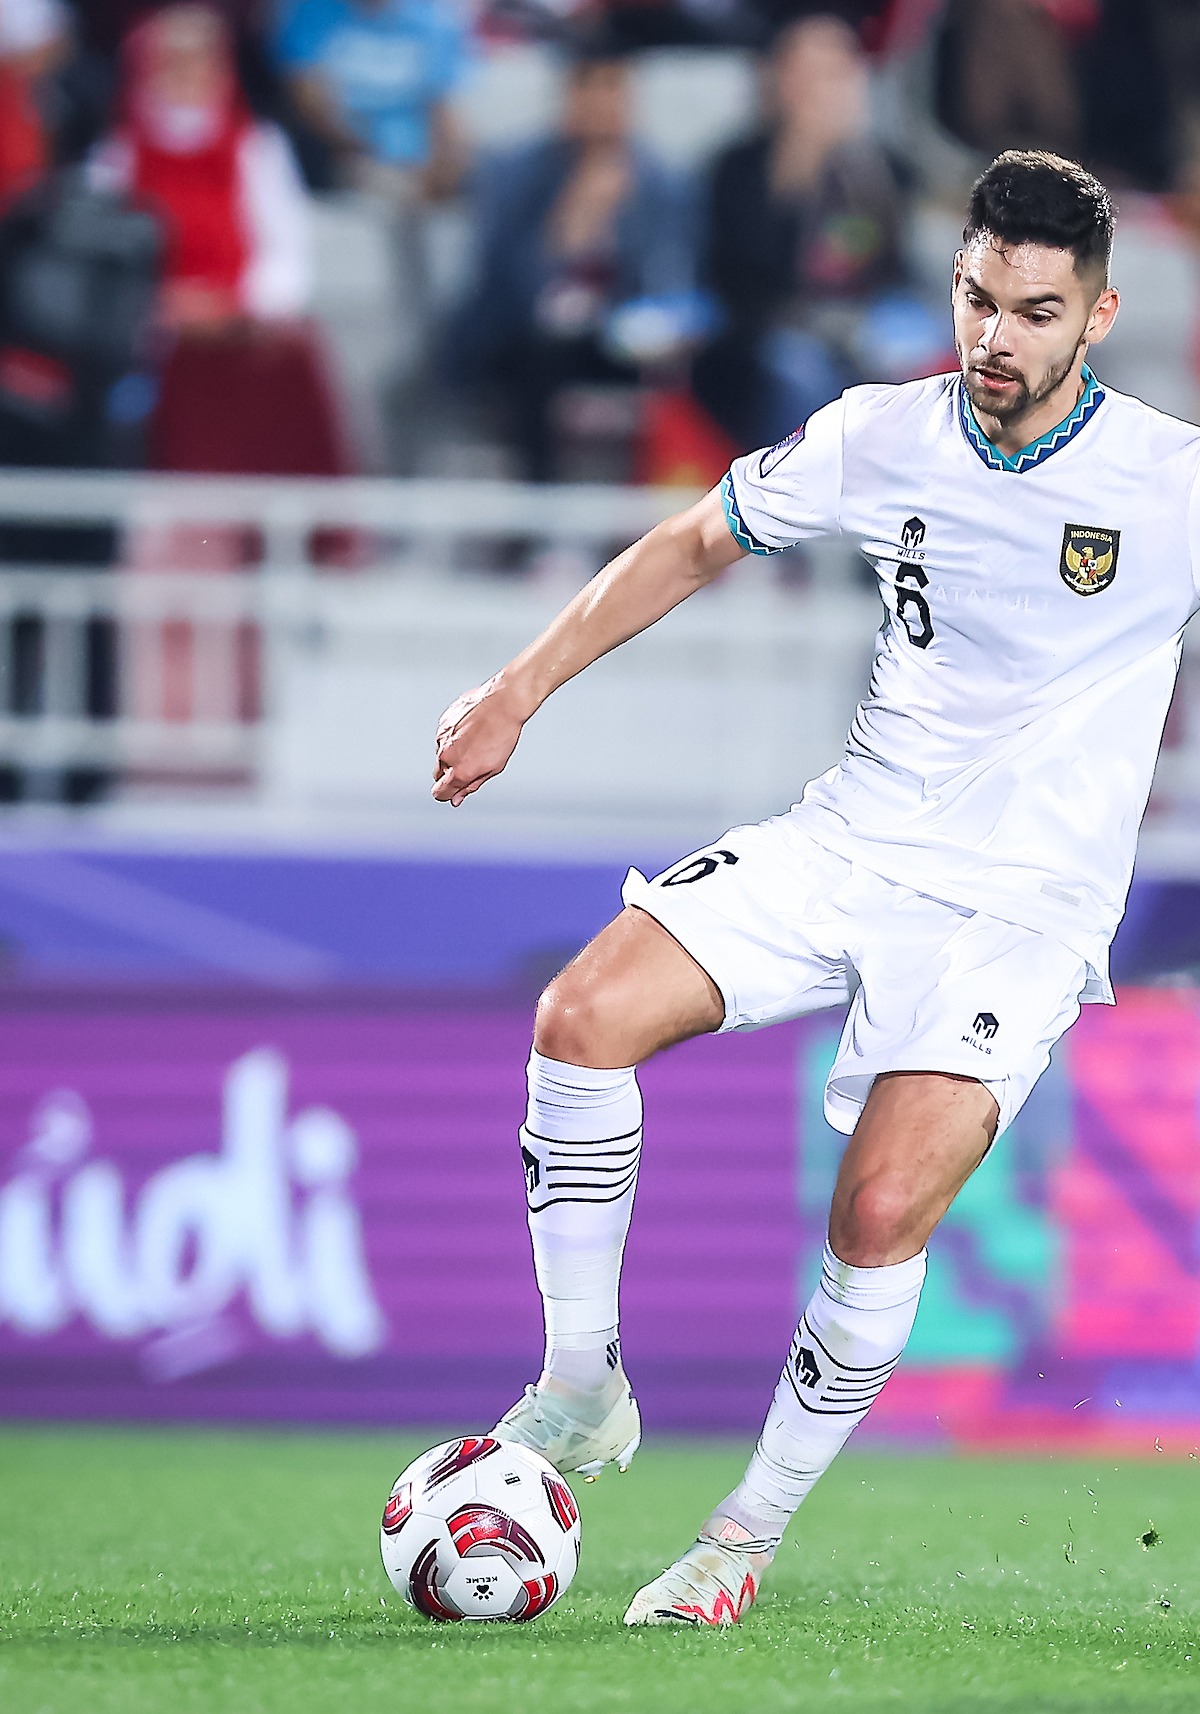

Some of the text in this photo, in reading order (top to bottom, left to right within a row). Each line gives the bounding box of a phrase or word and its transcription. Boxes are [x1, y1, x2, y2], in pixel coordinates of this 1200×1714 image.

[1070, 530, 1113, 545] INDONESIA
[896, 549, 926, 560] MILLS
[894, 562, 935, 650] 6
[660, 850, 740, 887] 6
[961, 1035, 992, 1055] MILLS
[465, 1576, 498, 1584] KELME
